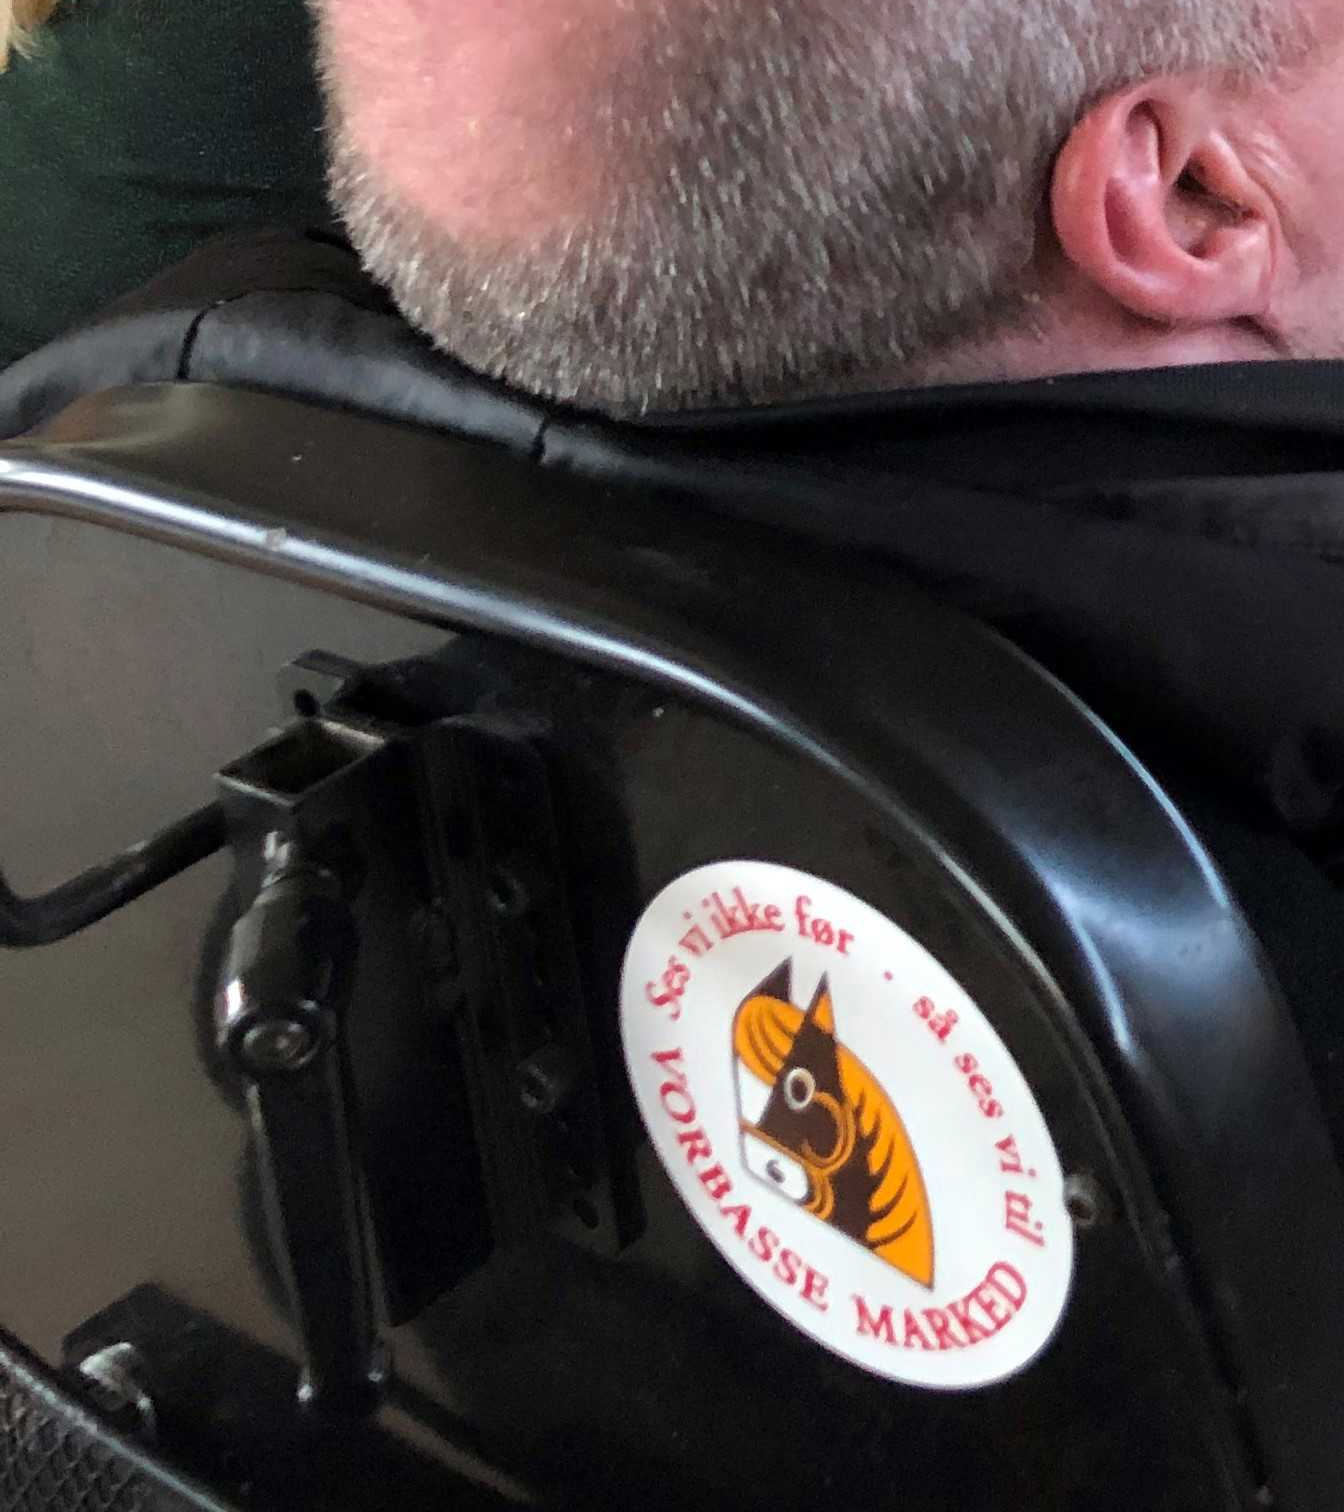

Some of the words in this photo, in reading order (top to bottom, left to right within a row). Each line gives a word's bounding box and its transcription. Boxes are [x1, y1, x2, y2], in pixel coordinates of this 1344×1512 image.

[679, 912, 714, 955] vi
[710, 888, 785, 939] ikke
[795, 895, 855, 955] før
[646, 955, 691, 1020] Ses
[913, 996, 959, 1043] så
[955, 1053, 1003, 1119] ses
[996, 1135, 1036, 1177] vi
[651, 1047, 829, 1312] VORBASSE
[852, 1261, 1027, 1351] MARKED
[1005, 1190, 1045, 1248] til
